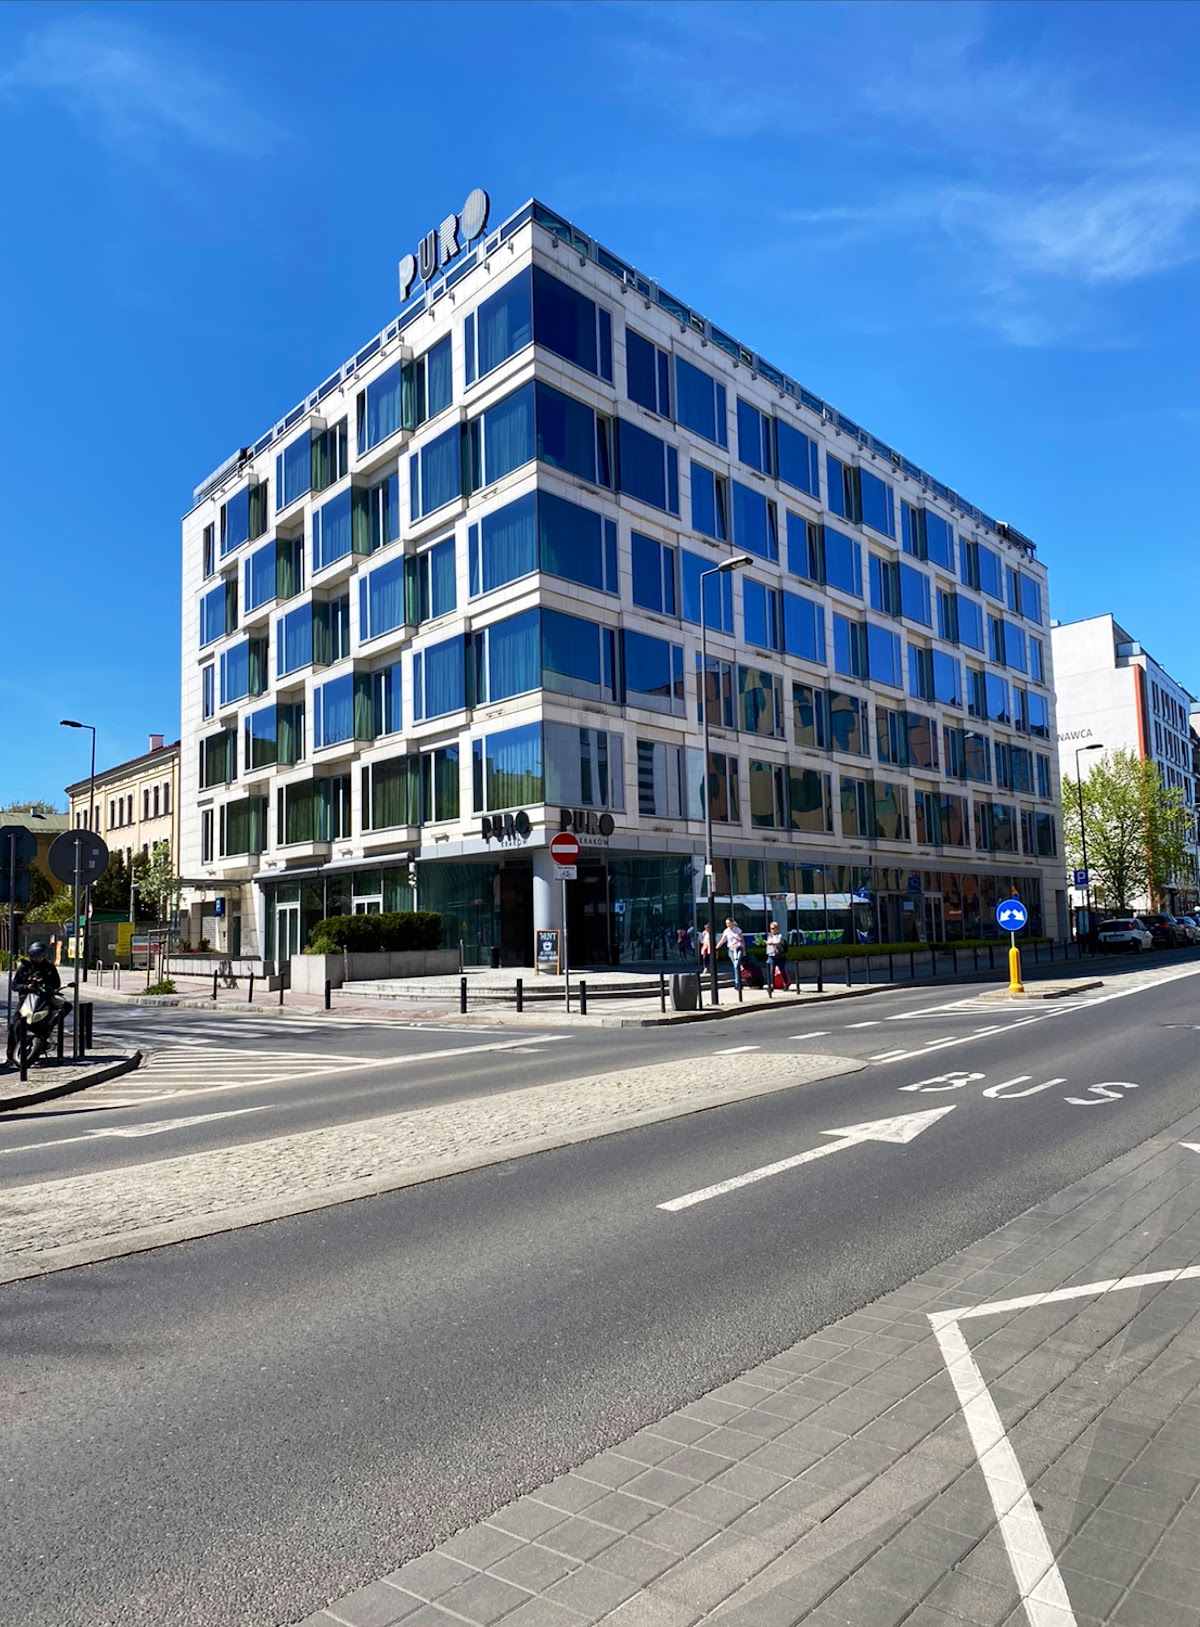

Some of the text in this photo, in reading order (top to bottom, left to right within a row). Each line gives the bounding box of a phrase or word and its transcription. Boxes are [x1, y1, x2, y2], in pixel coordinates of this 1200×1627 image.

[399, 188, 489, 302] PURO
[482, 811, 530, 839] PURO
[561, 809, 614, 836] PURO
[1077, 871, 1086, 883] P
[897, 1072, 1139, 1105] BUS
